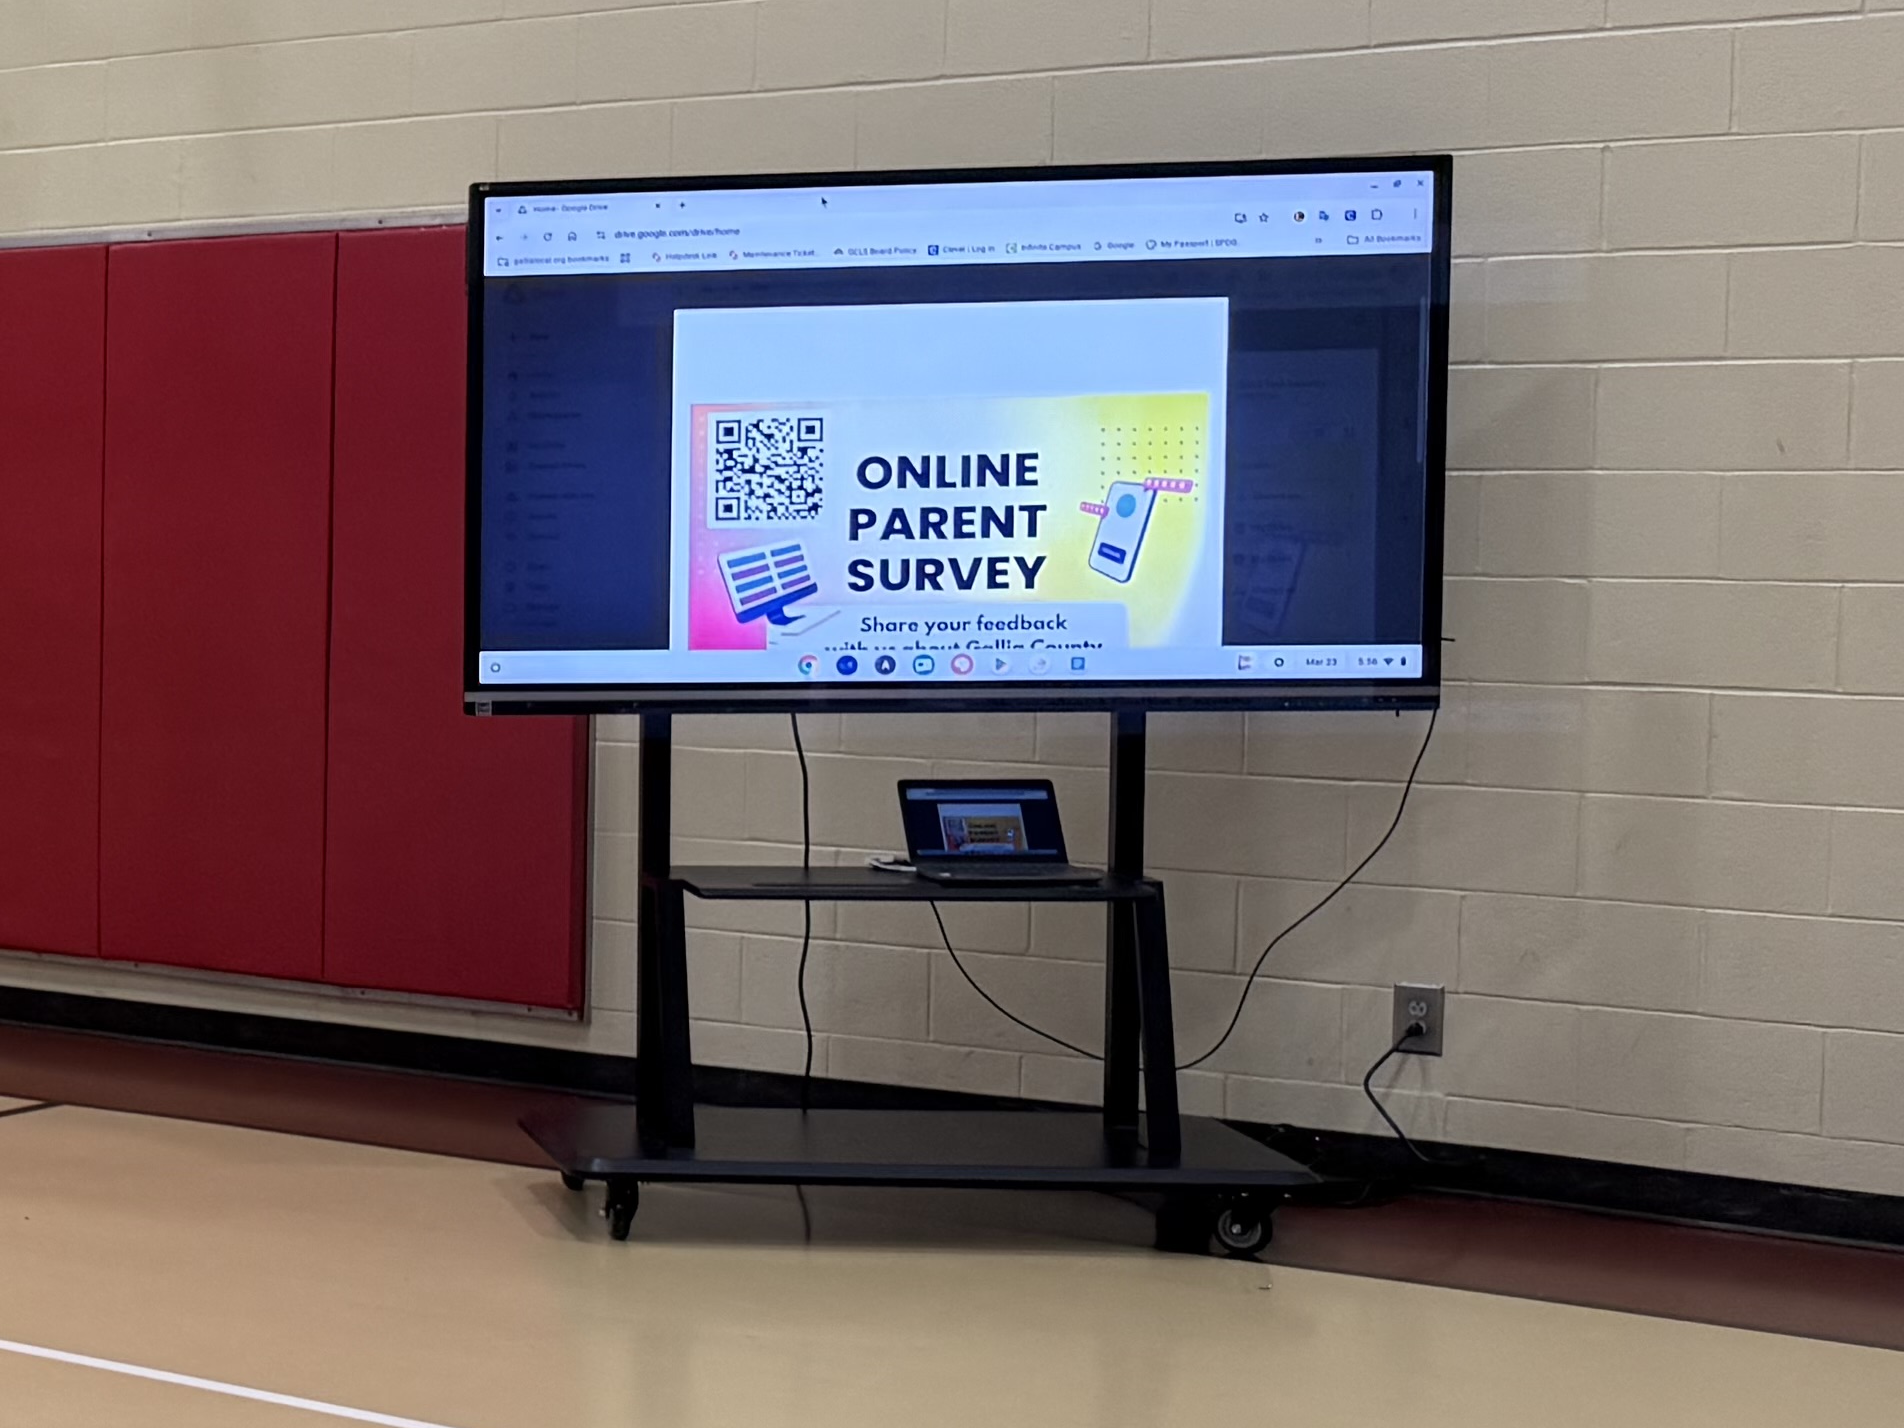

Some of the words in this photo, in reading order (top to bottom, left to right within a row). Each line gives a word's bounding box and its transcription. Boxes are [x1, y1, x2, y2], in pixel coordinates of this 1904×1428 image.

[856, 452, 1039, 490] ONLINE
[848, 504, 1047, 541] PARENT
[847, 555, 1047, 592] SURVEY
[860, 616, 919, 633] Share
[924, 619, 972, 636] your
[976, 613, 1068, 631] feedback
